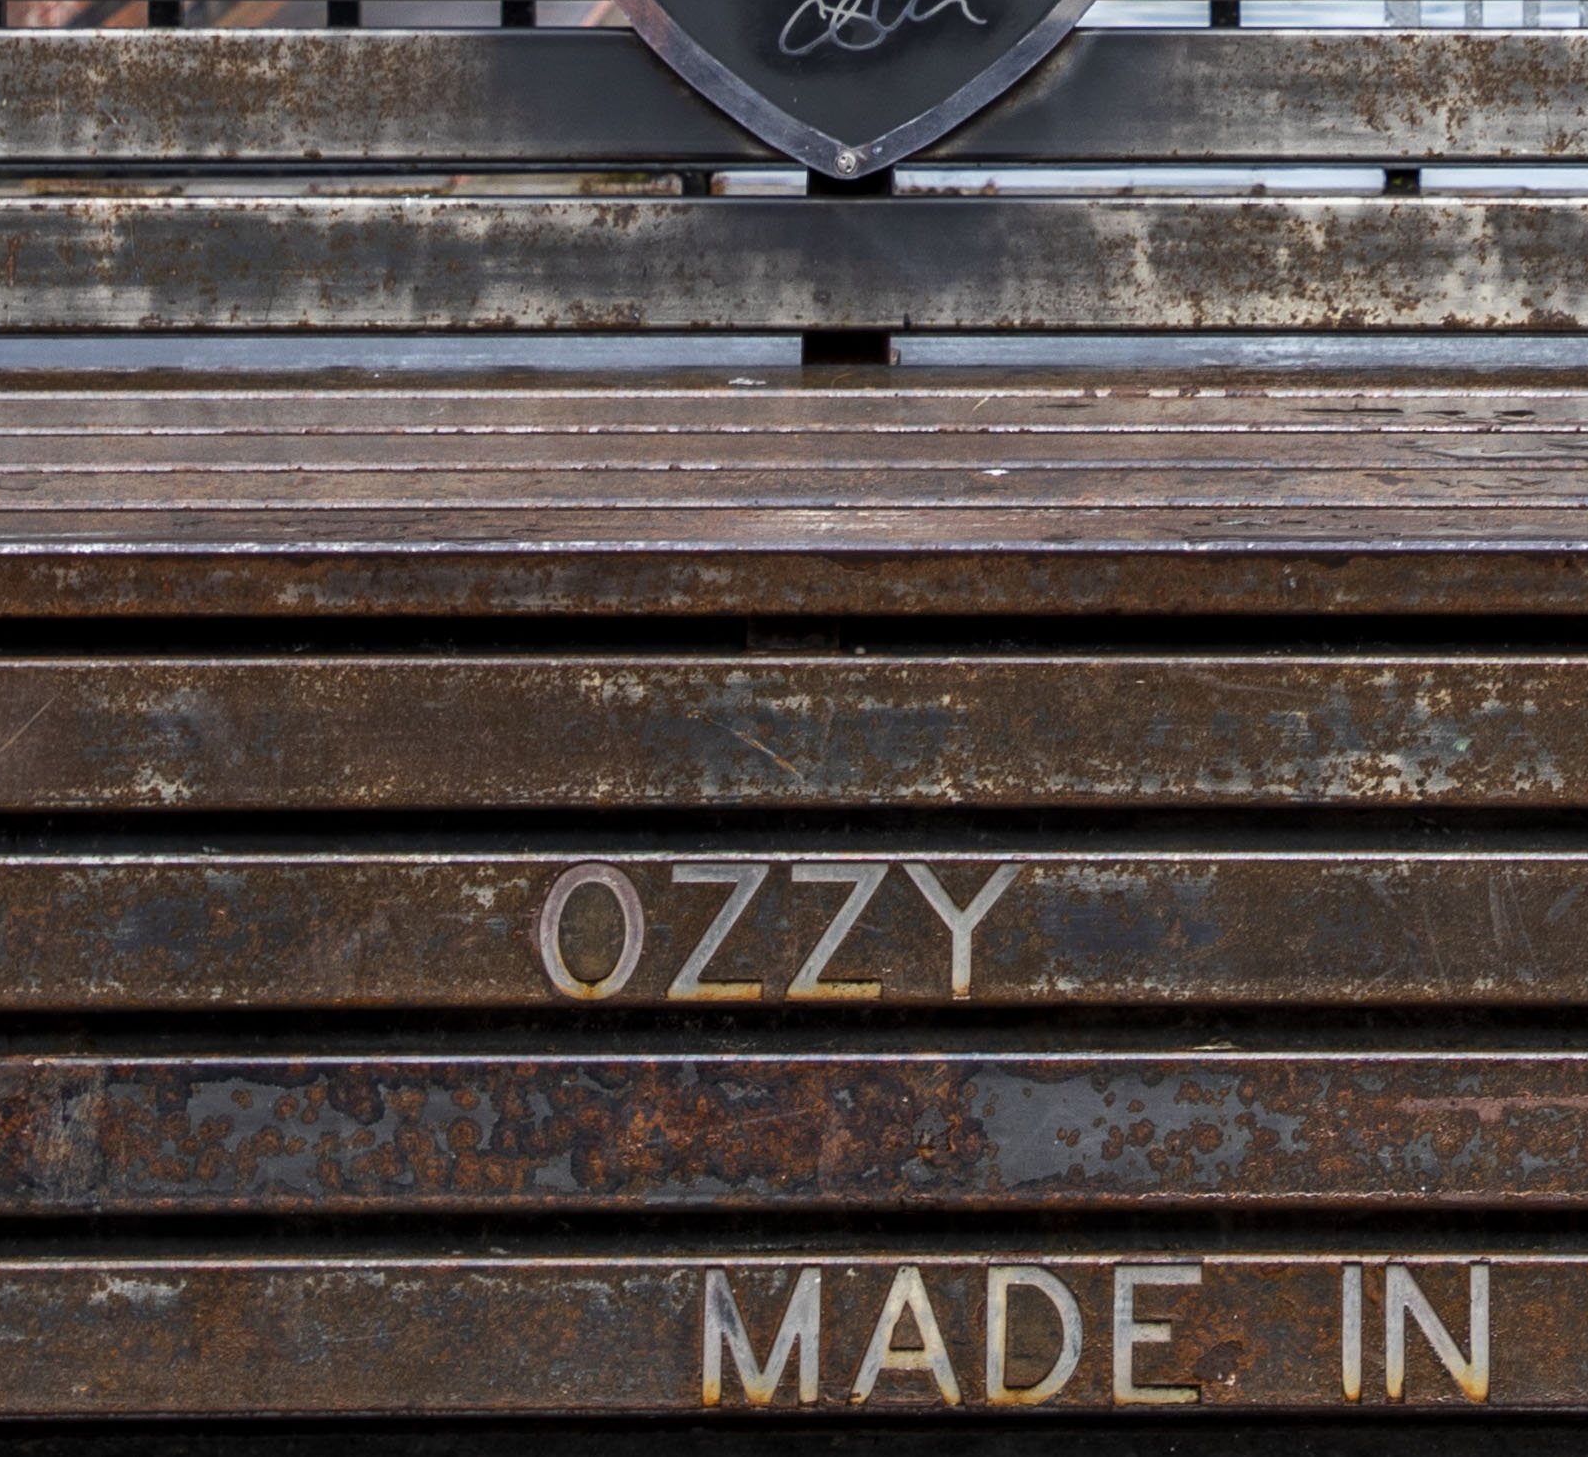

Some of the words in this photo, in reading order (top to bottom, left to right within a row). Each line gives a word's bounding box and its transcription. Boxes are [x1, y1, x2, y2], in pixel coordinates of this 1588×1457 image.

[534, 861, 1022, 1001] OZZY
[701, 1263, 1203, 1408] MADE
[1340, 1261, 1491, 1404] IN
